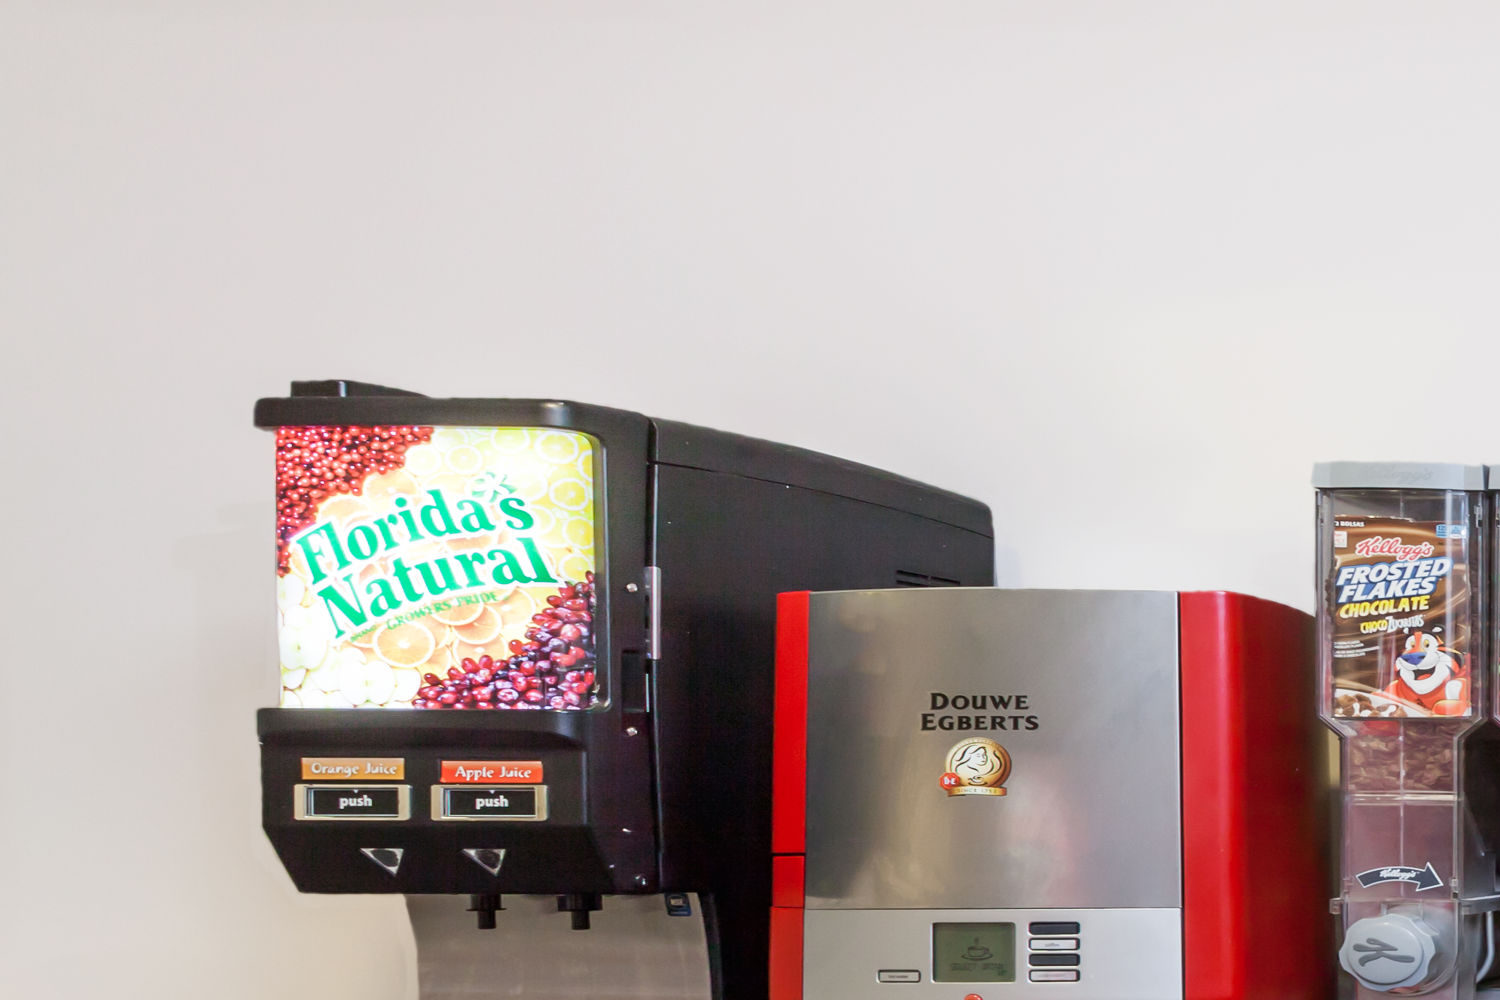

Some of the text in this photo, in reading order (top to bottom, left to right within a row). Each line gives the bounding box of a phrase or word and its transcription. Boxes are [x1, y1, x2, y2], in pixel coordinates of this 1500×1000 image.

[297, 489, 535, 585] Florida's
[1357, 537, 1433, 560] Kellogg's
[1337, 558, 1451, 586] FROSTED
[318, 537, 558, 639] Natural
[1338, 577, 1436, 603] FLAKES
[1340, 595, 1431, 618] CHOCOLATE
[929, 692, 1030, 711] DOUWE
[920, 713, 1040, 732] EGBERTS
[311, 762, 397, 778] Orange Juice
[455, 766, 532, 781] Apple Juice
[339, 795, 373, 810] push
[475, 795, 509, 810] push
